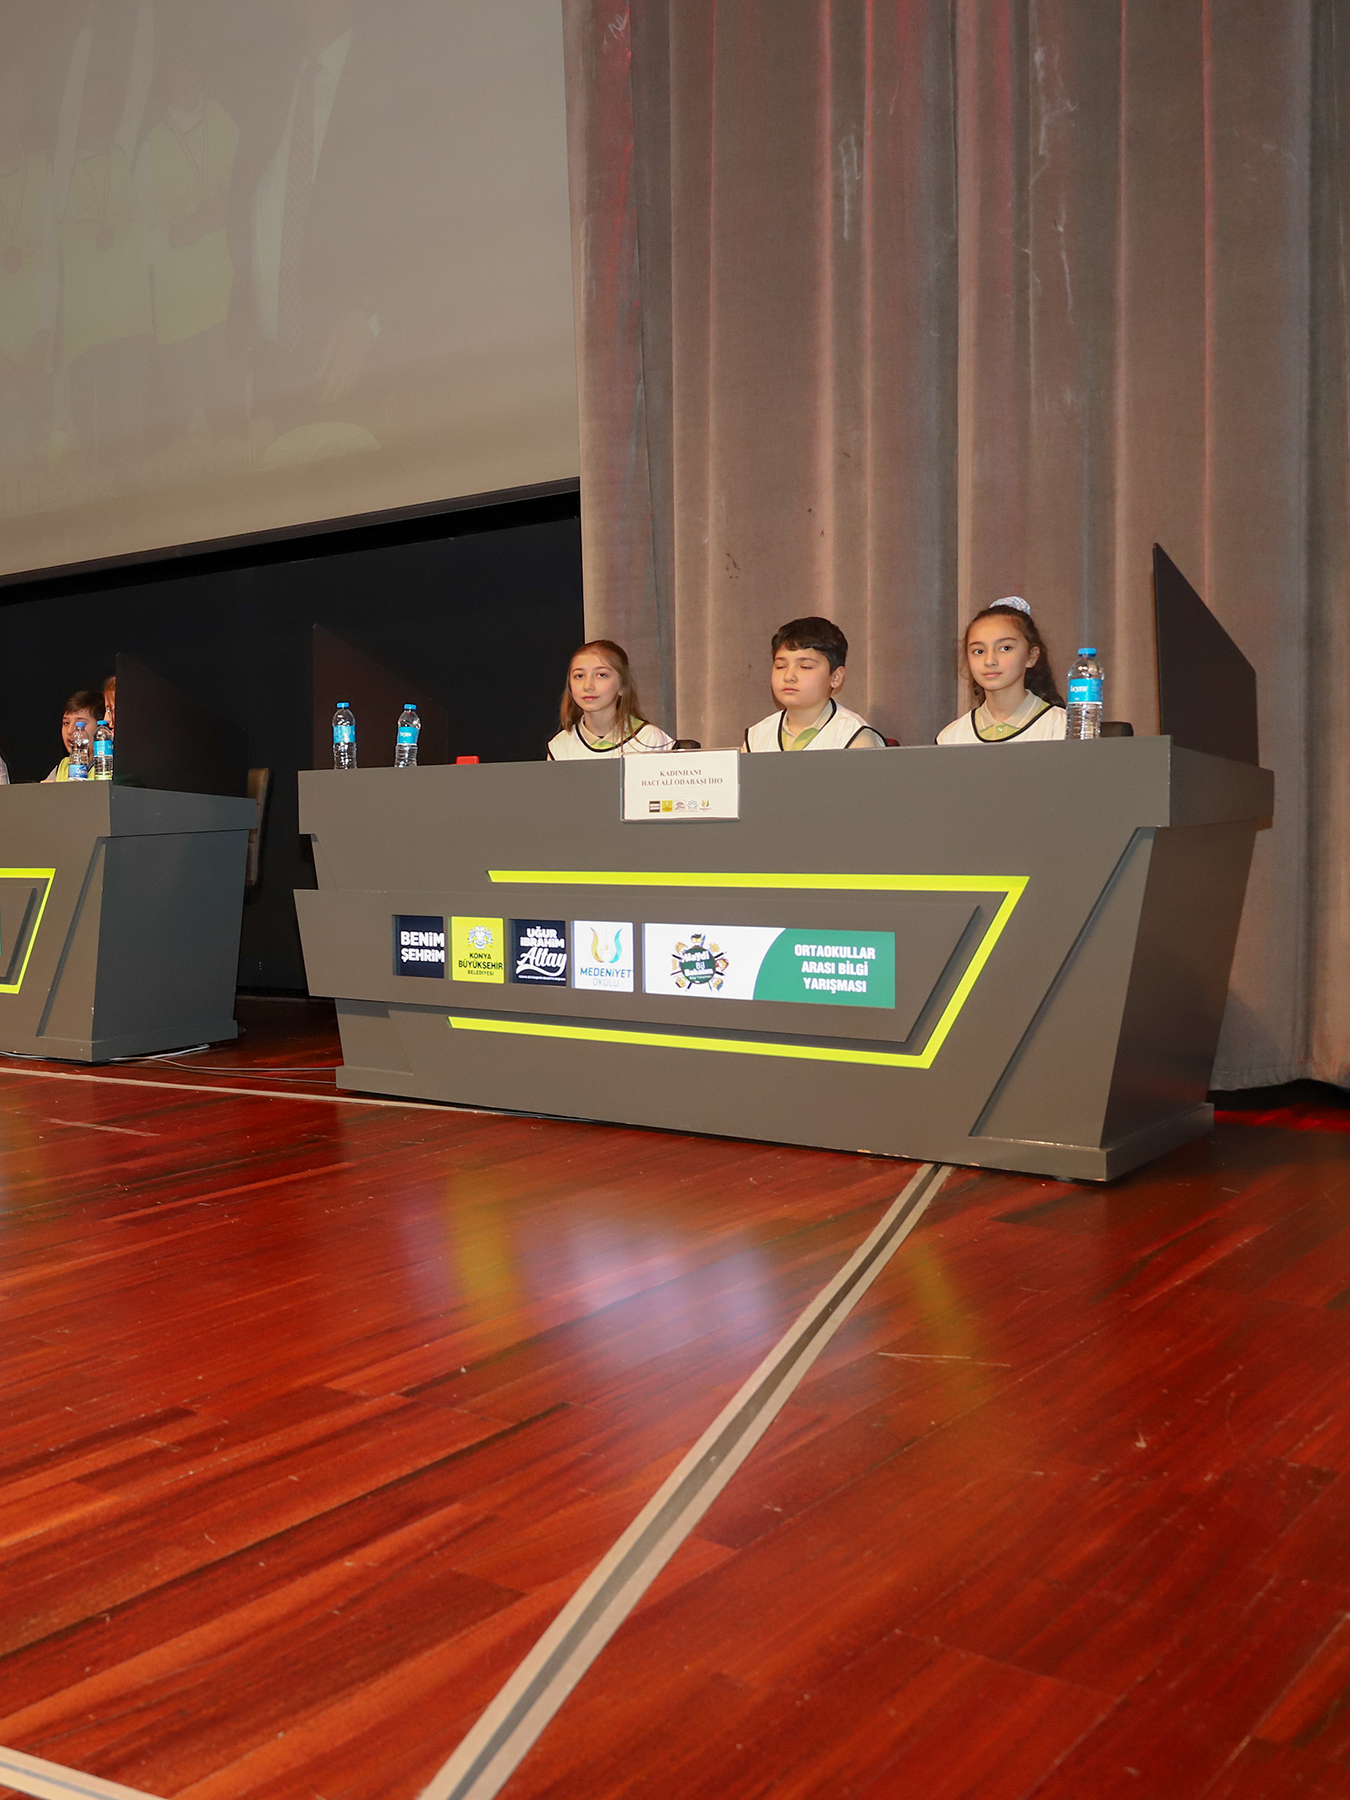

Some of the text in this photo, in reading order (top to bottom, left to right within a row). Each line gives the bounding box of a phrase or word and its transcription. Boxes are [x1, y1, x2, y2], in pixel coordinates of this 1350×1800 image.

[400, 931, 445, 947] BENİM
[526, 926, 558, 938] UĞUR
[469, 952, 492, 960] KONYA
[794, 944, 876, 959] ORTAOKULLAR
[516, 947, 567, 976] Altay
[801, 960, 869, 976] ARASI BİLGİ
[593, 977, 620, 987] OKULU
[803, 977, 867, 994] YARIŞMASI
